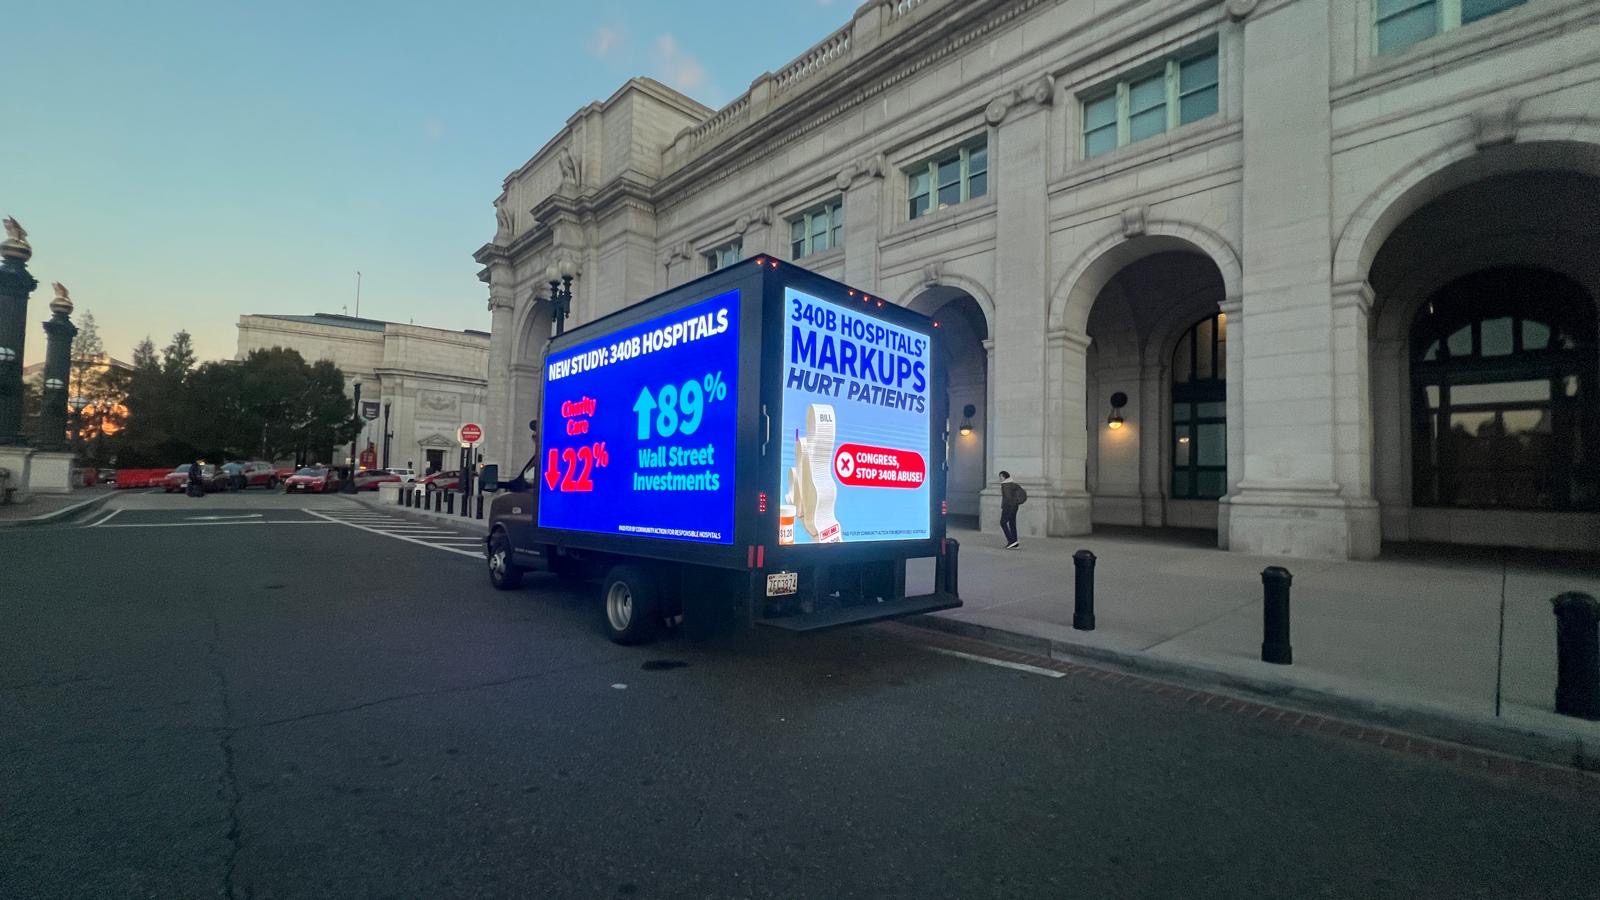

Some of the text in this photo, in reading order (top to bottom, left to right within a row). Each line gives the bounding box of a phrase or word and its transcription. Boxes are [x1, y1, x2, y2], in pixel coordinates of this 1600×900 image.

[791, 299, 836, 332] 340B
[548, 308, 728, 381] NEW STUDY: 340B HOSPITALS
[791, 325, 926, 393] MARKUPS
[787, 367, 926, 414] HURT PATIENTS
[562, 396, 597, 417] Charity
[656, 371, 727, 438] 89%
[566, 419, 589, 435] Care
[820, 413, 833, 422] BILL
[561, 441, 609, 492] 22%
[639, 444, 715, 468] Wall Street
[856, 452, 900, 469] CONGRESS,
[633, 470, 720, 491] Investments
[855, 467, 923, 483] STOP 340B ABUSE!
[700, 531, 721, 539] HOSPITALS
